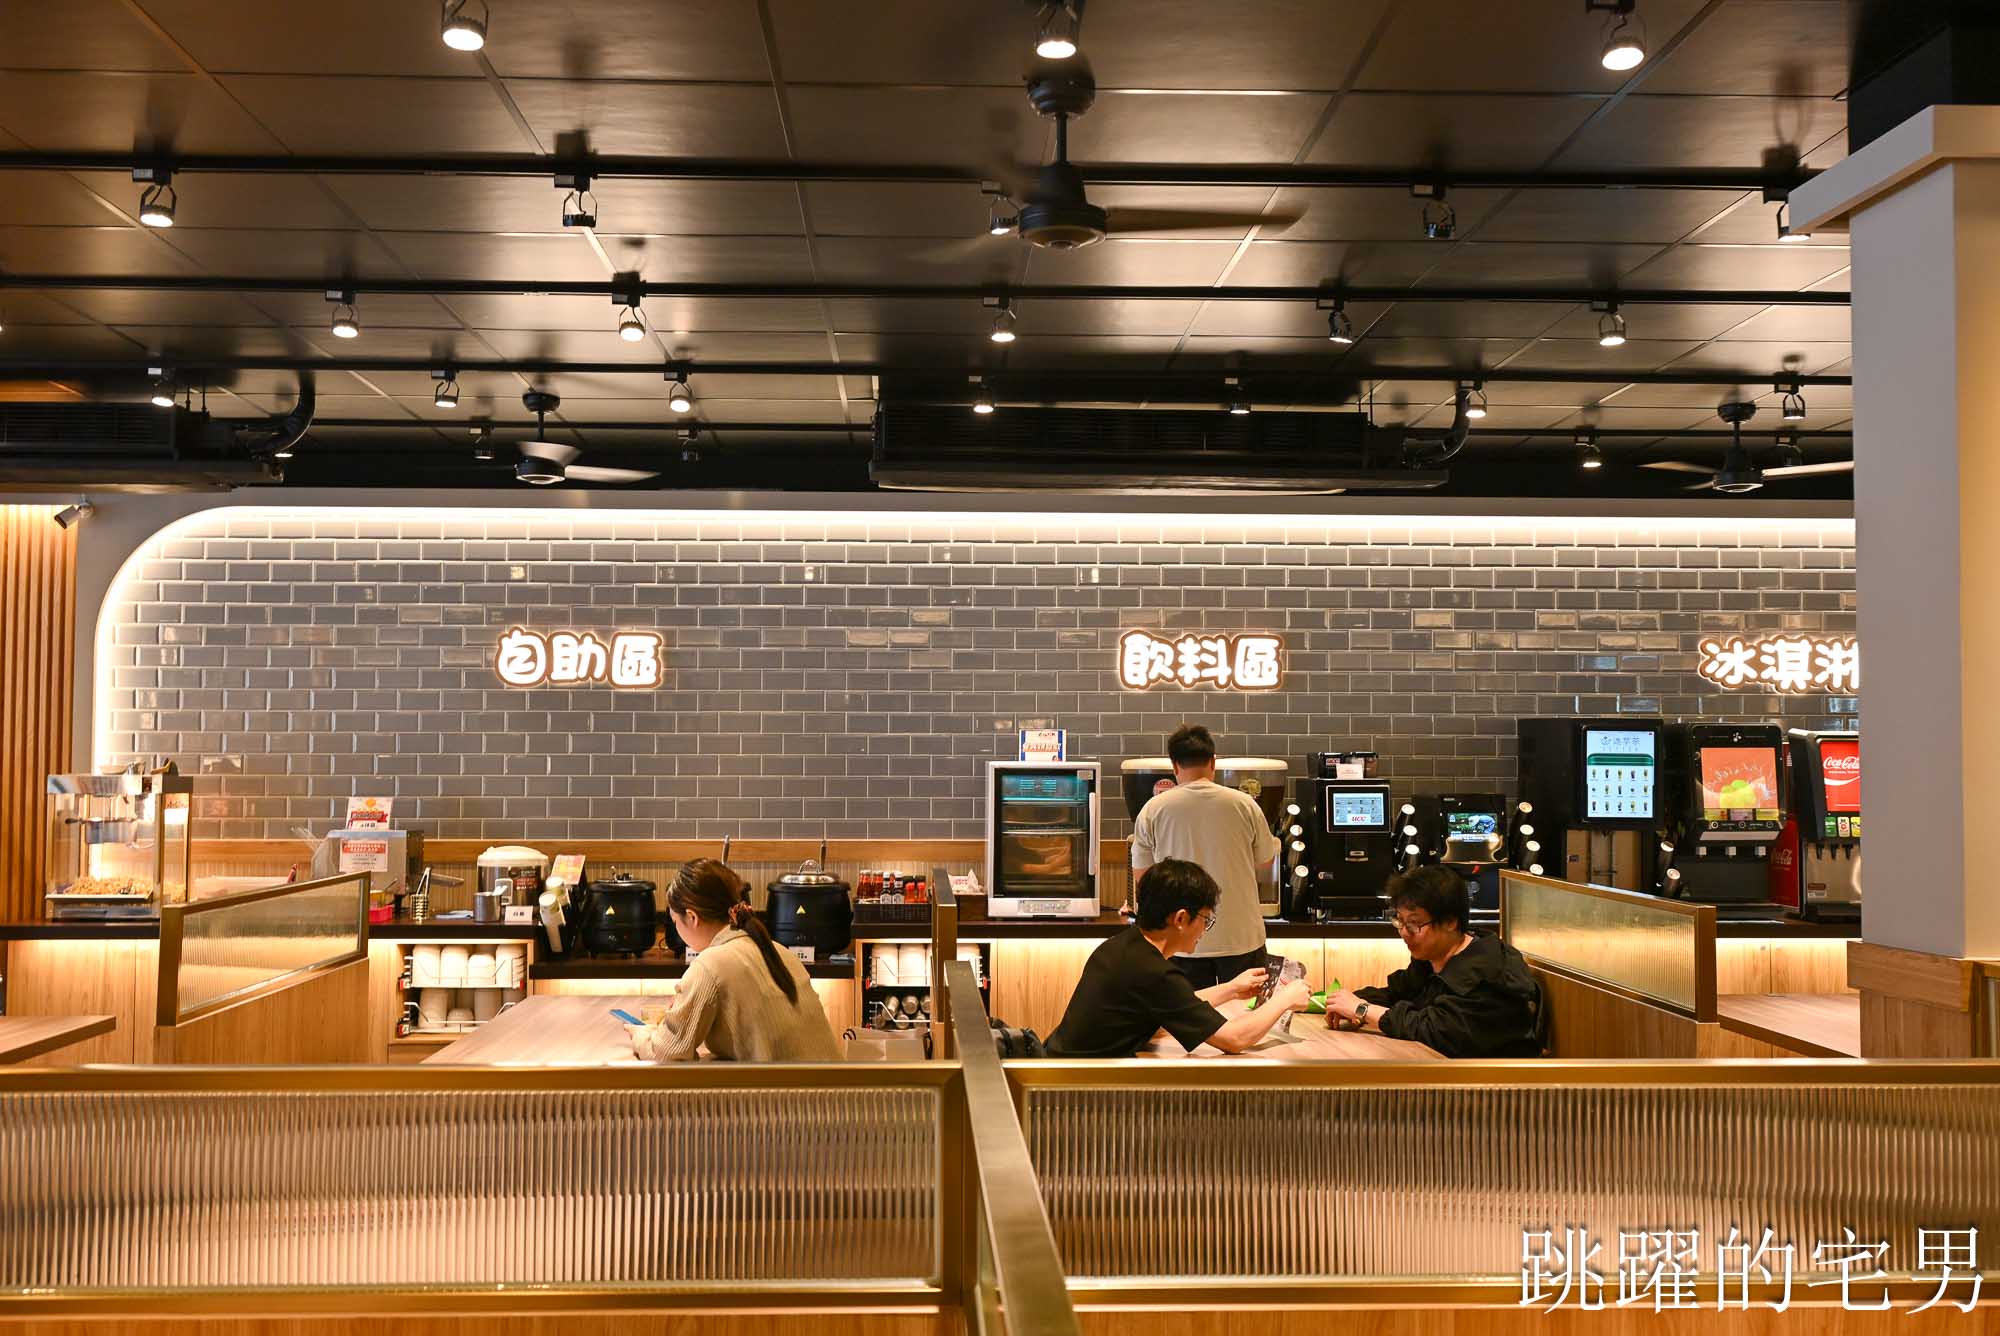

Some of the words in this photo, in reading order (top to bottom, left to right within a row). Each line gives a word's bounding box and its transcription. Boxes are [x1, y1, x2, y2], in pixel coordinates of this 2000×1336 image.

[497, 628, 661, 687] 自助區
[1122, 631, 1281, 688] 飲料區
